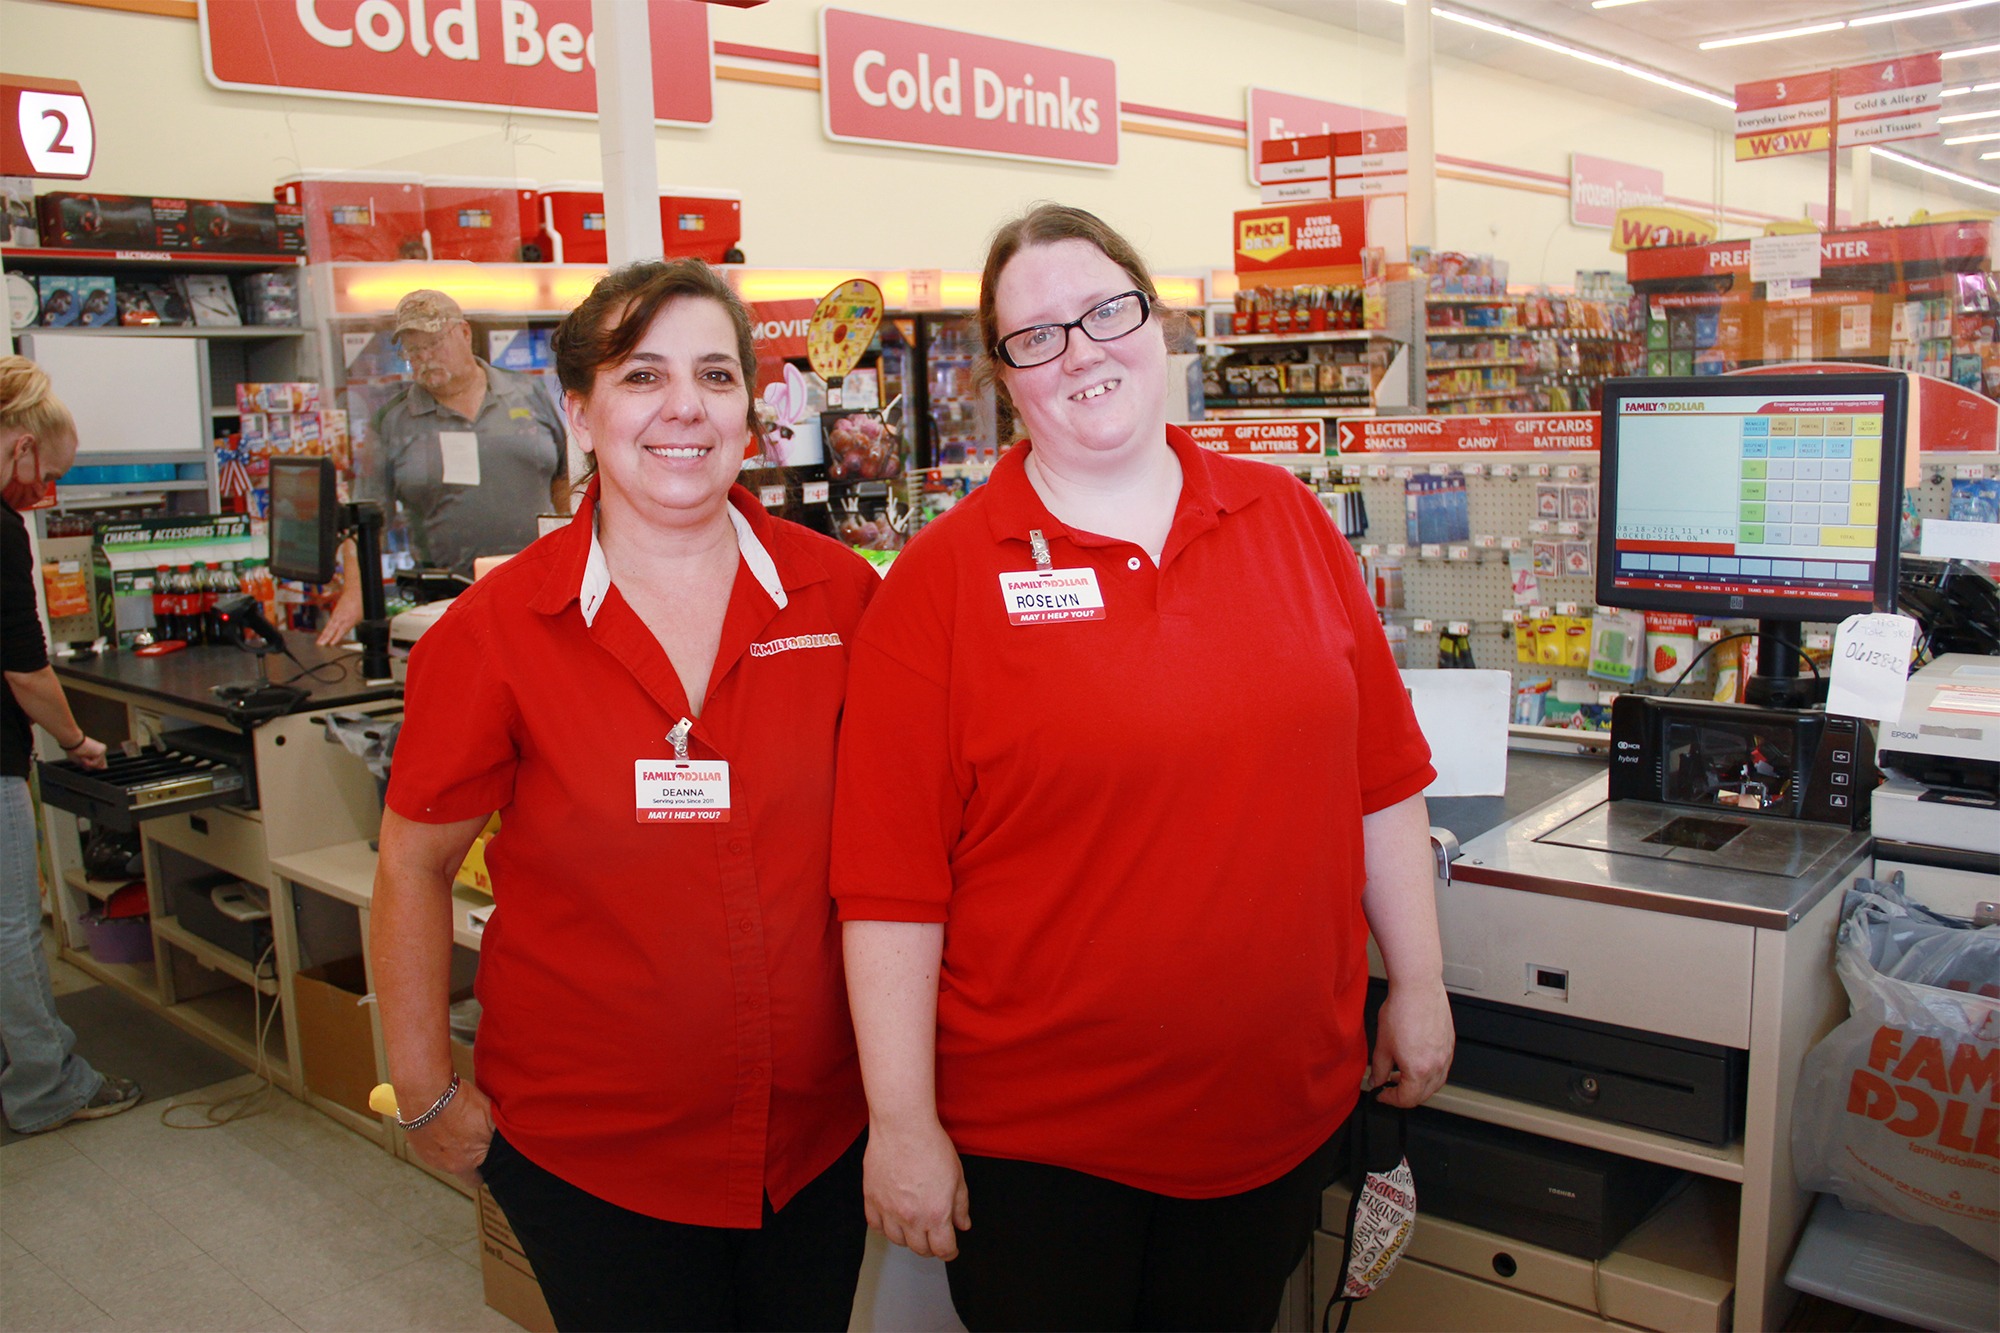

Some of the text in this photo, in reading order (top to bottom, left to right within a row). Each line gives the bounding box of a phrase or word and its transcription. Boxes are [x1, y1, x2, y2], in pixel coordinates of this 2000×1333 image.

[295, 0, 597, 72] Cold Be
[1881, 65, 1895, 82] 4
[853, 49, 1100, 135] Cold Drinks
[1776, 82, 1787, 99] 3
[1854, 92, 1927, 110] Cold & Allergy
[1738, 107, 1827, 127] Everyday Low Prices!
[41, 110, 74, 154] 2
[1854, 121, 1922, 137] Facial Tissues
[1367, 133, 1378, 148] 2
[1291, 141, 1299, 156] 1
[1305, 216, 1332, 226] EVEN
[1245, 222, 1285, 237] PRICE
[1297, 224, 1340, 239] LOWER
[1296, 236, 1342, 250] PRICES!
[115, 251, 173, 262] ELECTRONICS
[1625, 401, 1705, 412] FAMILY DOLLAR
[1191, 425, 1298, 438] CANDY GIFT CARDS
[1364, 422, 1442, 435] ELECTRONICS
[1515, 420, 1593, 434] GIFT CARDS
[1197, 440, 1299, 451] NACKS BATTERIES
[1365, 435, 1593, 449] SNACKS CANDY BATTERIES
[103, 529, 152, 545] CHARGING
[153, 525, 215, 541] ACCESSORIES
[217, 524, 229, 536] TO
[231, 523, 245, 535] GO
[1616, 531, 1681, 541] LOCKED-SIGN
[1617, 525, 1675, 534] 08-18-2021
[1008, 577, 1089, 590] FAMILY DOLLAR
[1016, 593, 1080, 609] ROSELYN
[1020, 609, 1095, 622] MAY I HELP YOU?
[751, 638, 789, 657] FAMILY
[1891, 730, 1918, 740] EPSON
[1618, 755, 1639, 763] hybrid
[643, 772, 721, 782] FAMILY DOLLAR
[662, 788, 704, 797] DEANNA
[648, 811, 721, 820] MAY I HELP YOU?
[1548, 1187, 1576, 1198] TOSHIBA
[1351, 1227, 1390, 1274] LOVE
